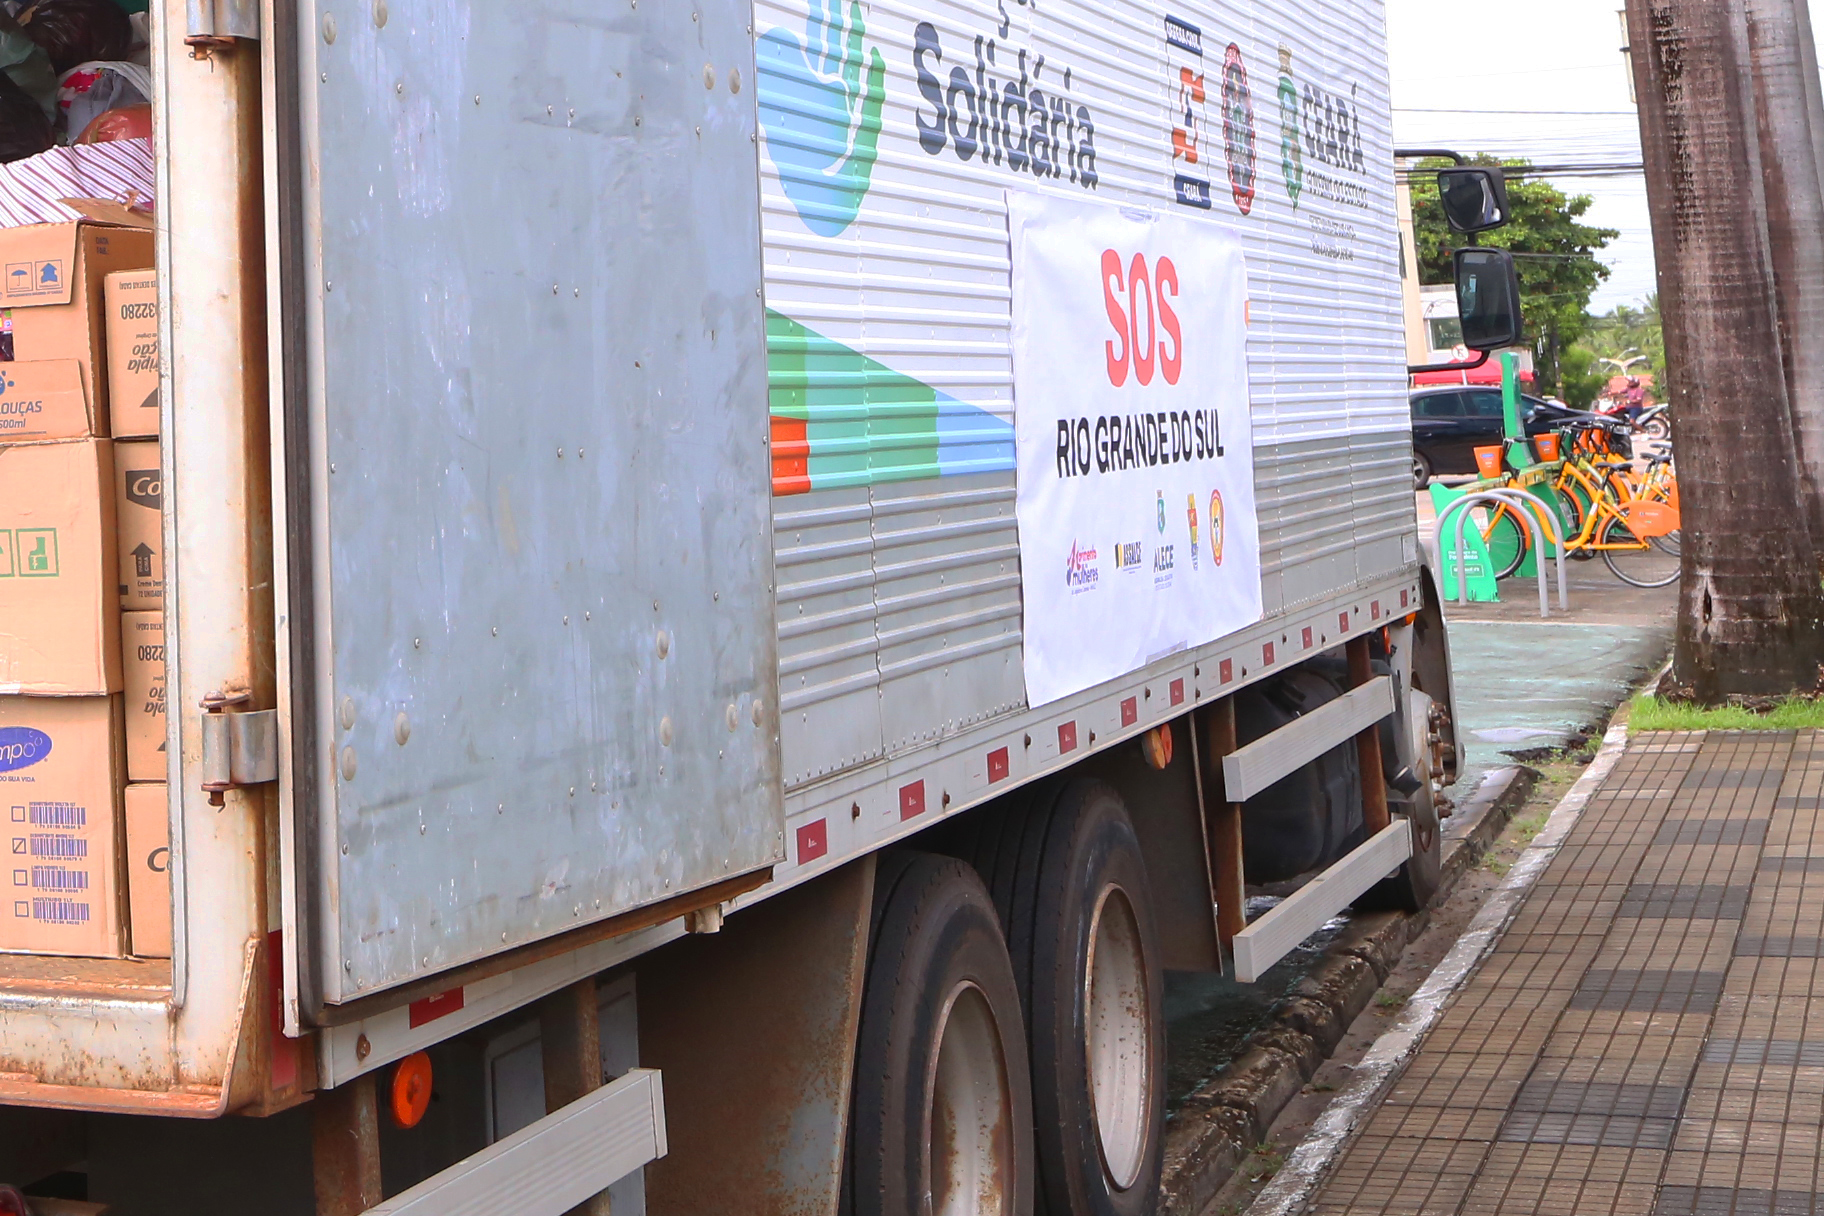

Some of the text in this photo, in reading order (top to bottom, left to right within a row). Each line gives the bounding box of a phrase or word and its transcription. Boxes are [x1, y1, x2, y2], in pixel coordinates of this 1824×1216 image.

[913, 21, 1098, 192] Solidária
[120, 302, 157, 320] 32280
[1101, 249, 1182, 388] SOS
[132, 343, 157, 359] ção
[127, 356, 158, 374] ripla
[1057, 408, 1225, 478] RIO GRANDE DO SUL
[1153, 544, 1174, 574] ALECE
[144, 589, 162, 598] UNIDADE
[138, 644, 164, 662] 2280
[8, 775, 20, 783] SUA
